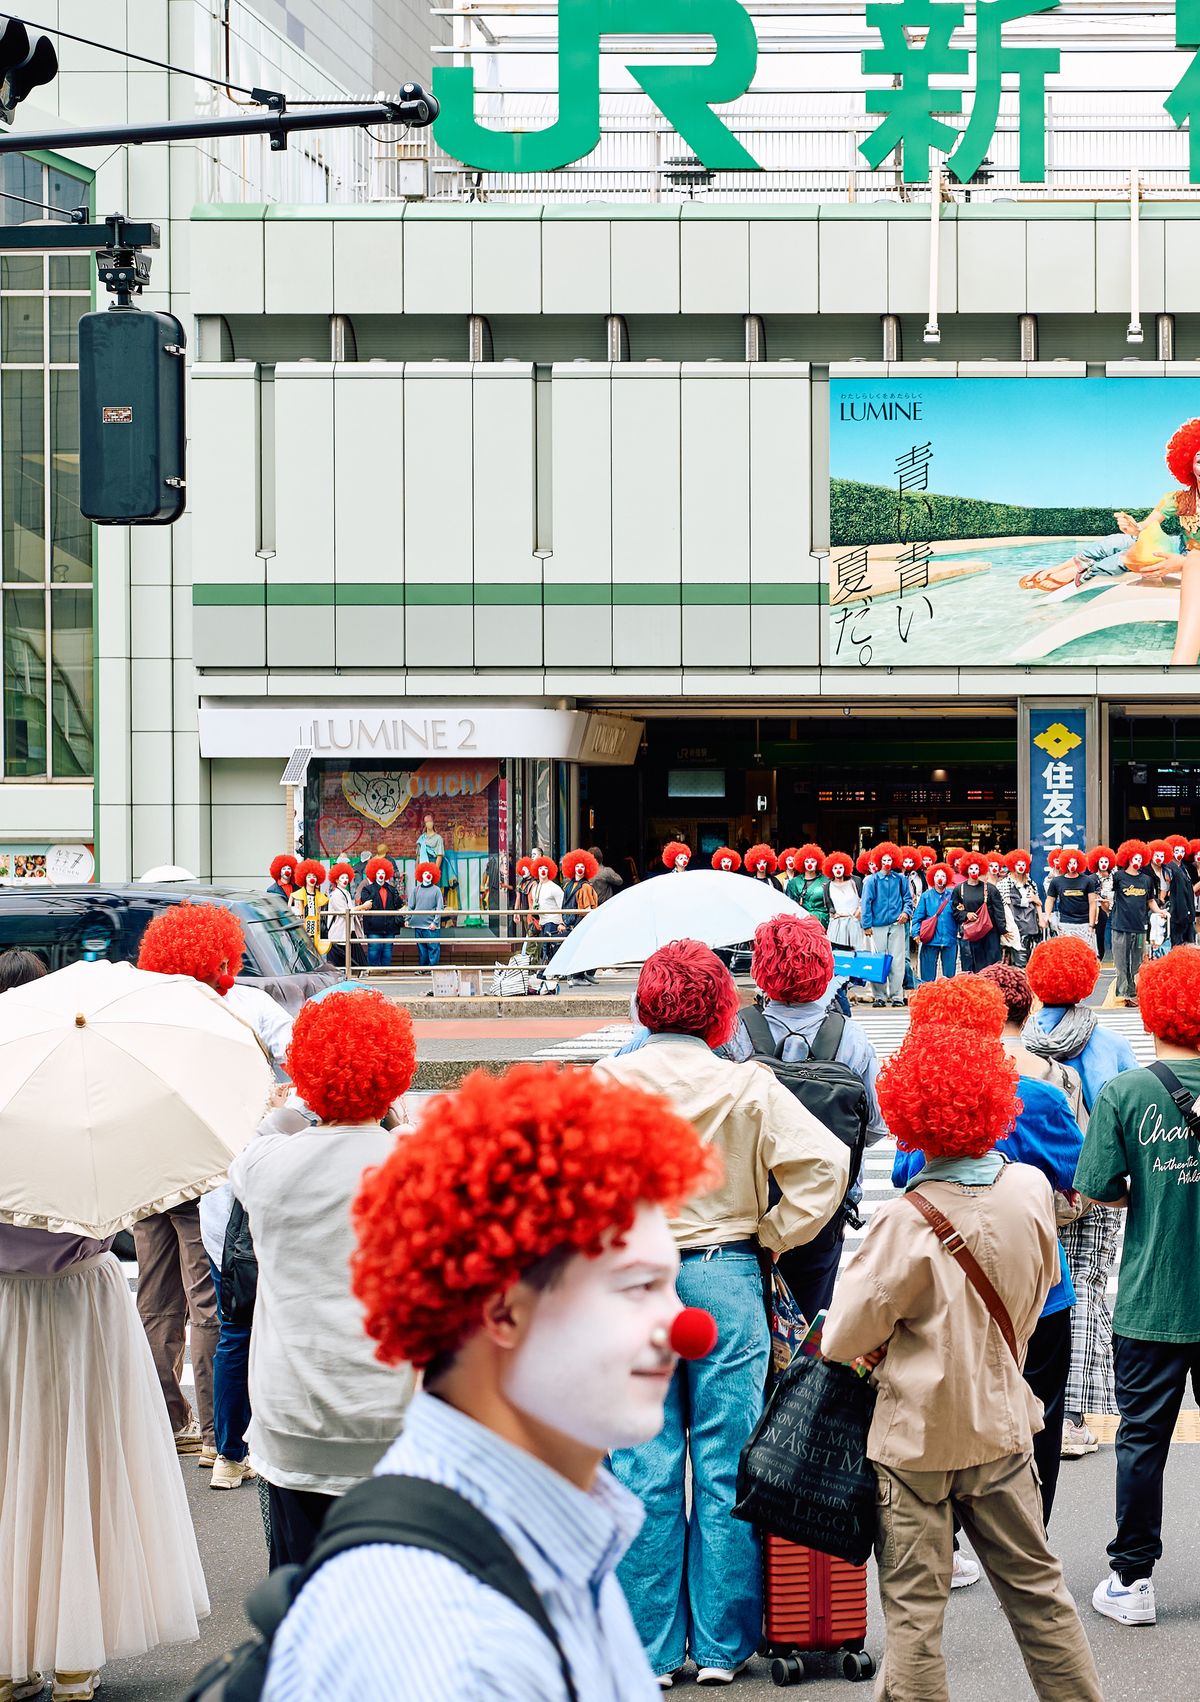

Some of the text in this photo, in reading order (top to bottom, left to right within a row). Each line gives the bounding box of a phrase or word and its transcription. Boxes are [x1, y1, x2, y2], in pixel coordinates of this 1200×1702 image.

[433, 0, 763, 172] JR
[840, 402, 923, 421] LUMINE
[830, 544, 874, 667] 夏だ。
[312, 719, 478, 751] LUMINE 2
[1152, 1155, 1199, 1172] Authentic
